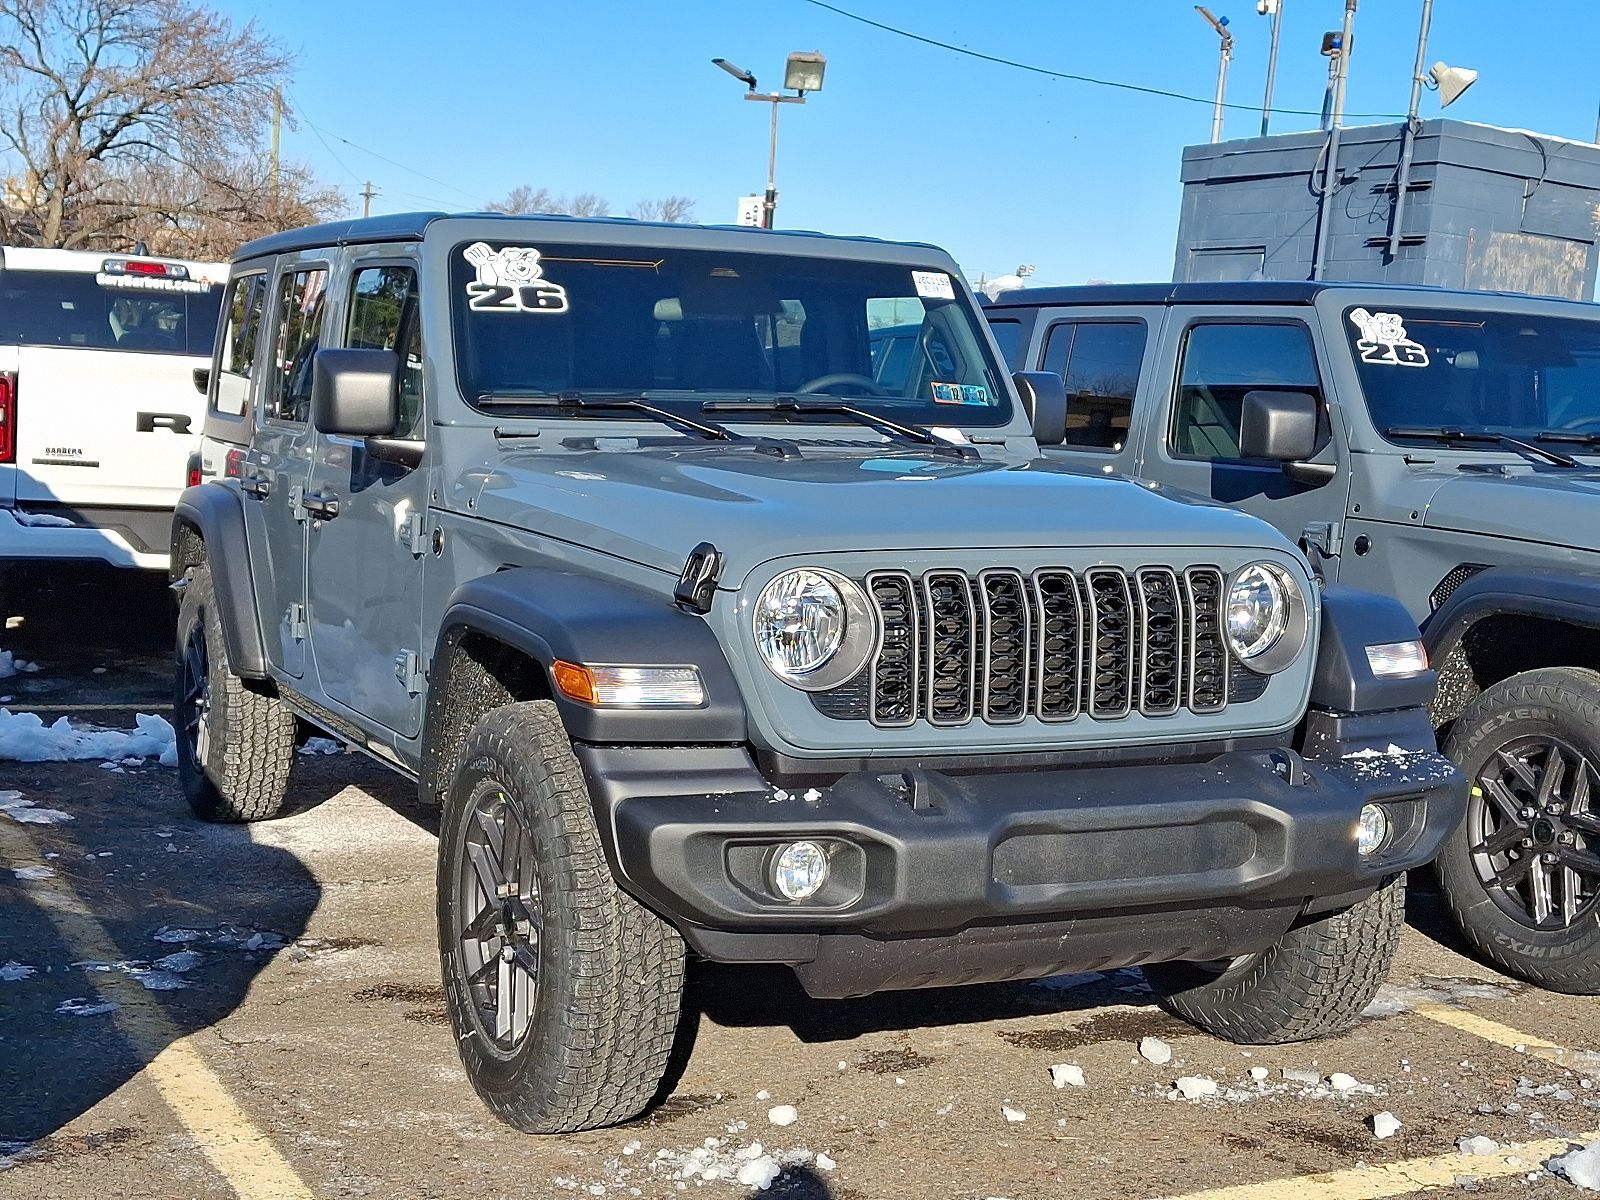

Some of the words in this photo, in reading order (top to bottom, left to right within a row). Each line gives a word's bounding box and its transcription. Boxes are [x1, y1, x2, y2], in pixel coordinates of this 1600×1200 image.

[469, 283, 566, 310] 26
[1359, 341, 1428, 365] 26
[1468, 708, 1548, 747] NEXEN
